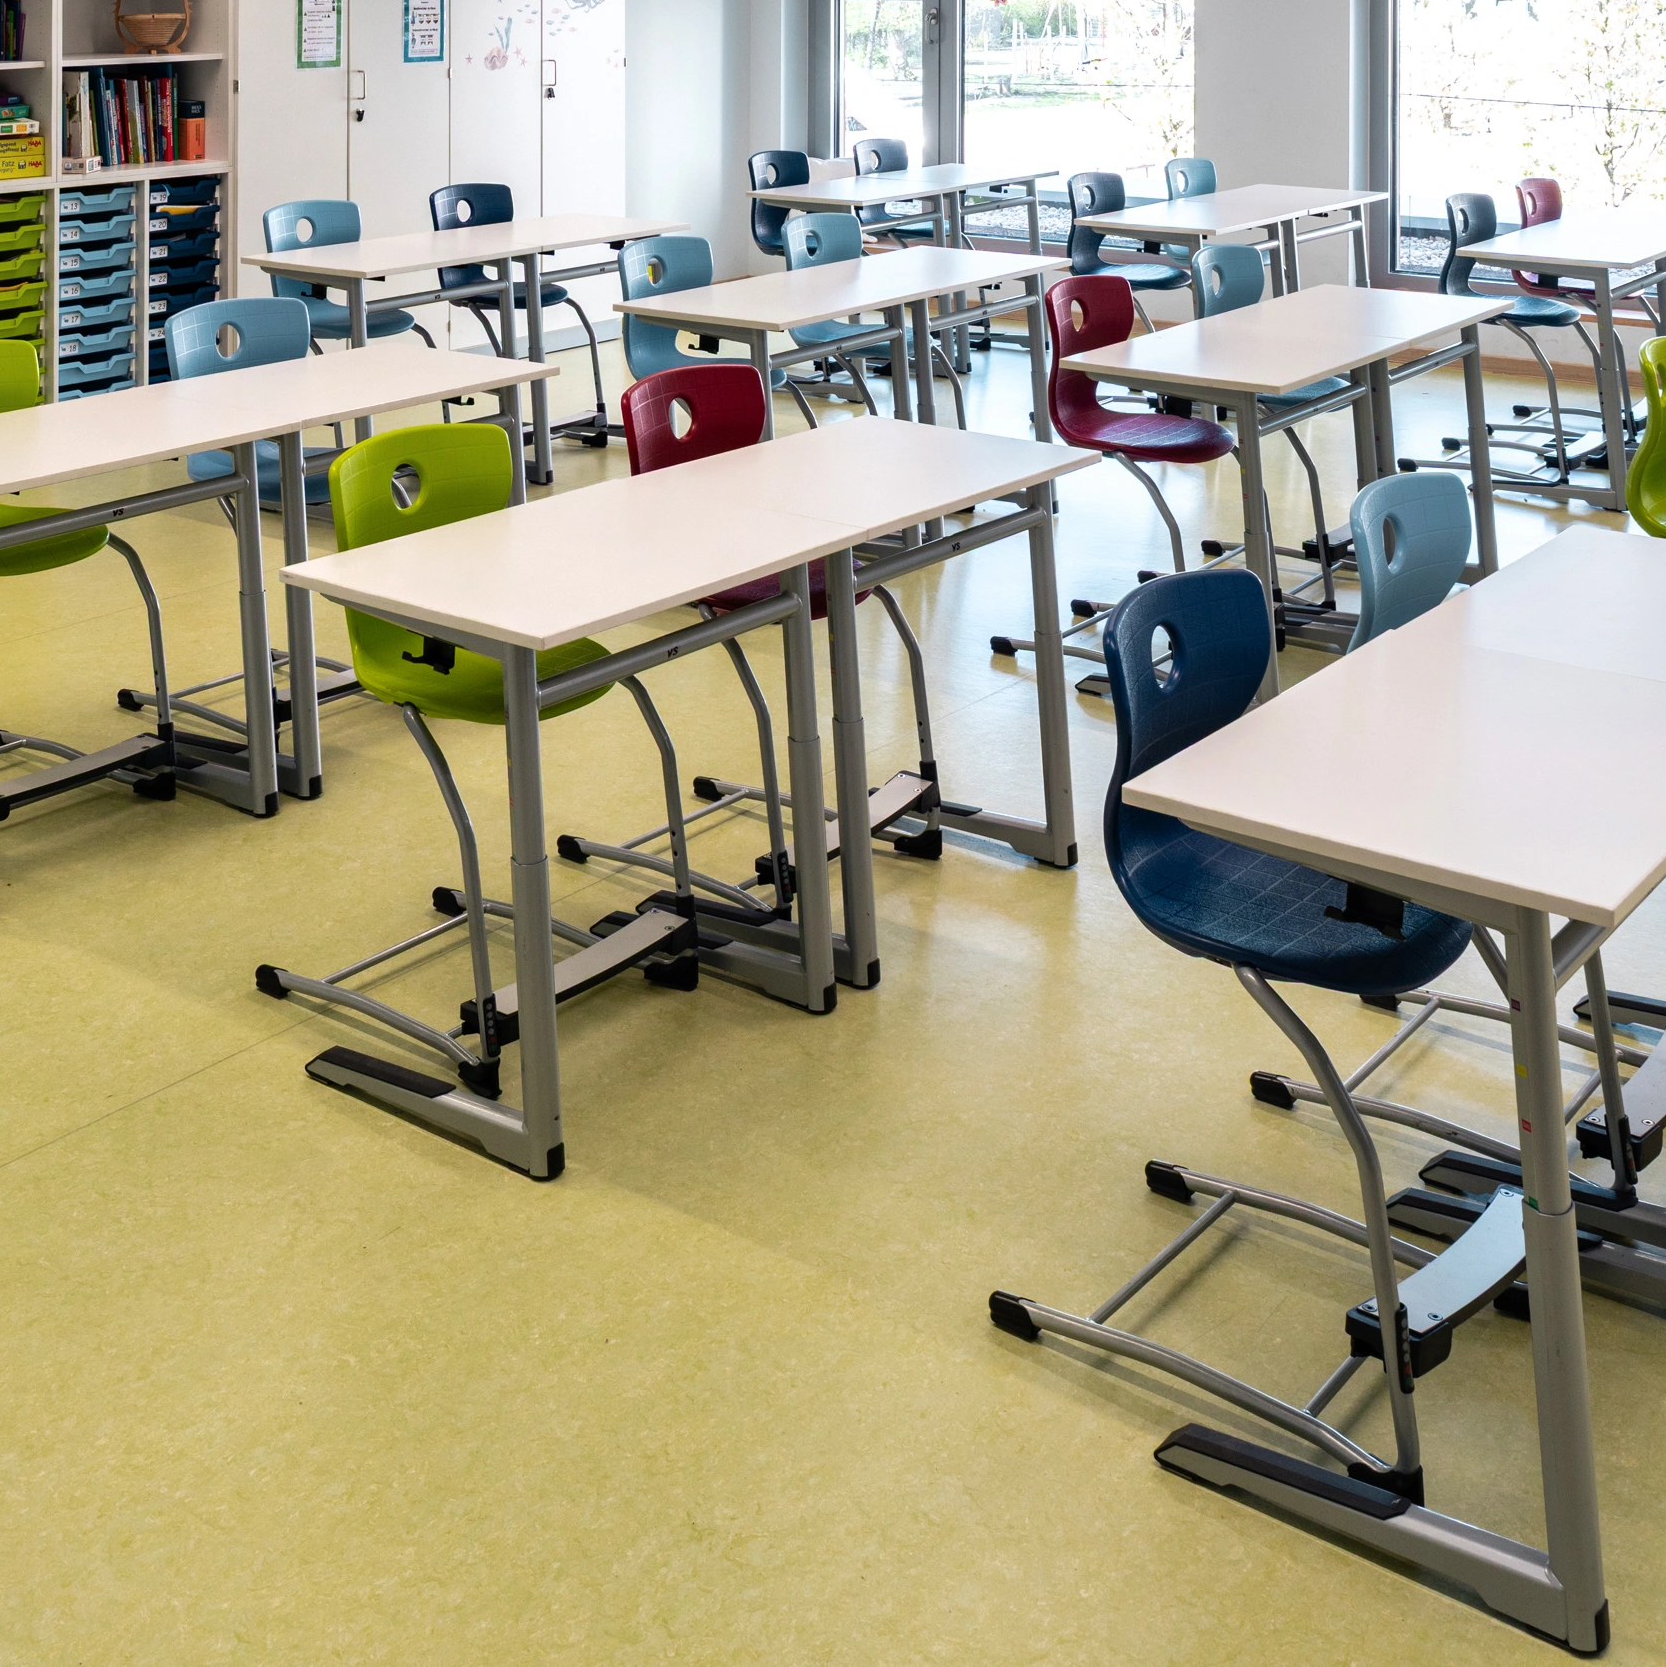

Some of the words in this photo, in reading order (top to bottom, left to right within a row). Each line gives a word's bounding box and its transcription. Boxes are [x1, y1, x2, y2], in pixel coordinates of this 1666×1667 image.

[29, 160, 43, 168] HABA
[70, 202, 78, 210] 13
[158, 220, 167, 229] 20
[70, 231, 78, 239] 14
[158, 248, 166, 256] 21
[70, 259, 79, 267] 15
[158, 275, 166, 283] 22
[71, 287, 79, 295] 16
[158, 302, 166, 310] 23
[71, 315, 79, 324] 17
[68, 344, 77, 352] 18
[112, 508, 124, 517] VS
[951, 541, 961, 552] VS
[667, 646, 678, 658] VS
